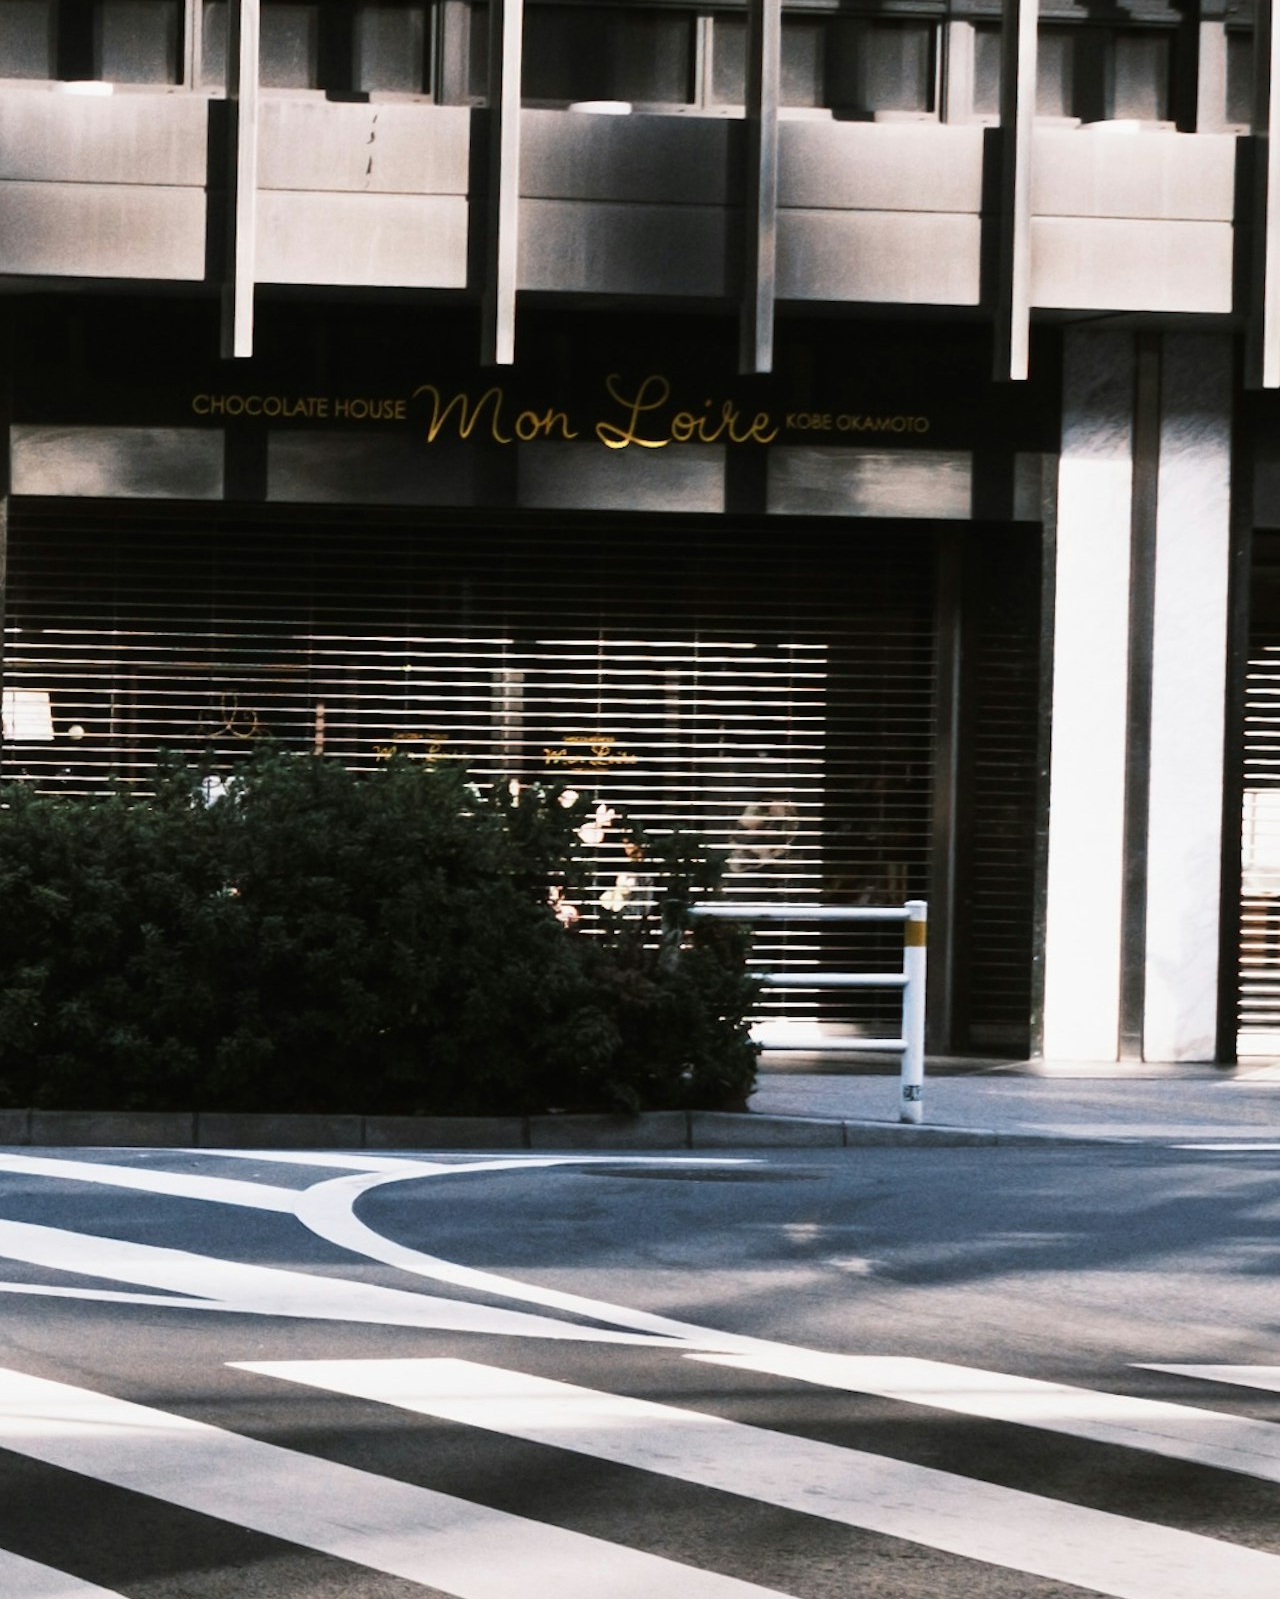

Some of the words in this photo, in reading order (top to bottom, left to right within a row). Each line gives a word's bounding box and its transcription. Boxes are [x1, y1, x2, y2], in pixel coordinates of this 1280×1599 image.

[192, 394, 329, 418] CHOCOLATE
[335, 397, 408, 420] HOUSE
[411, 383, 579, 445] Mon
[595, 373, 780, 451] Loire
[785, 413, 832, 431] KOBE
[836, 415, 930, 433] OKAMOTO
